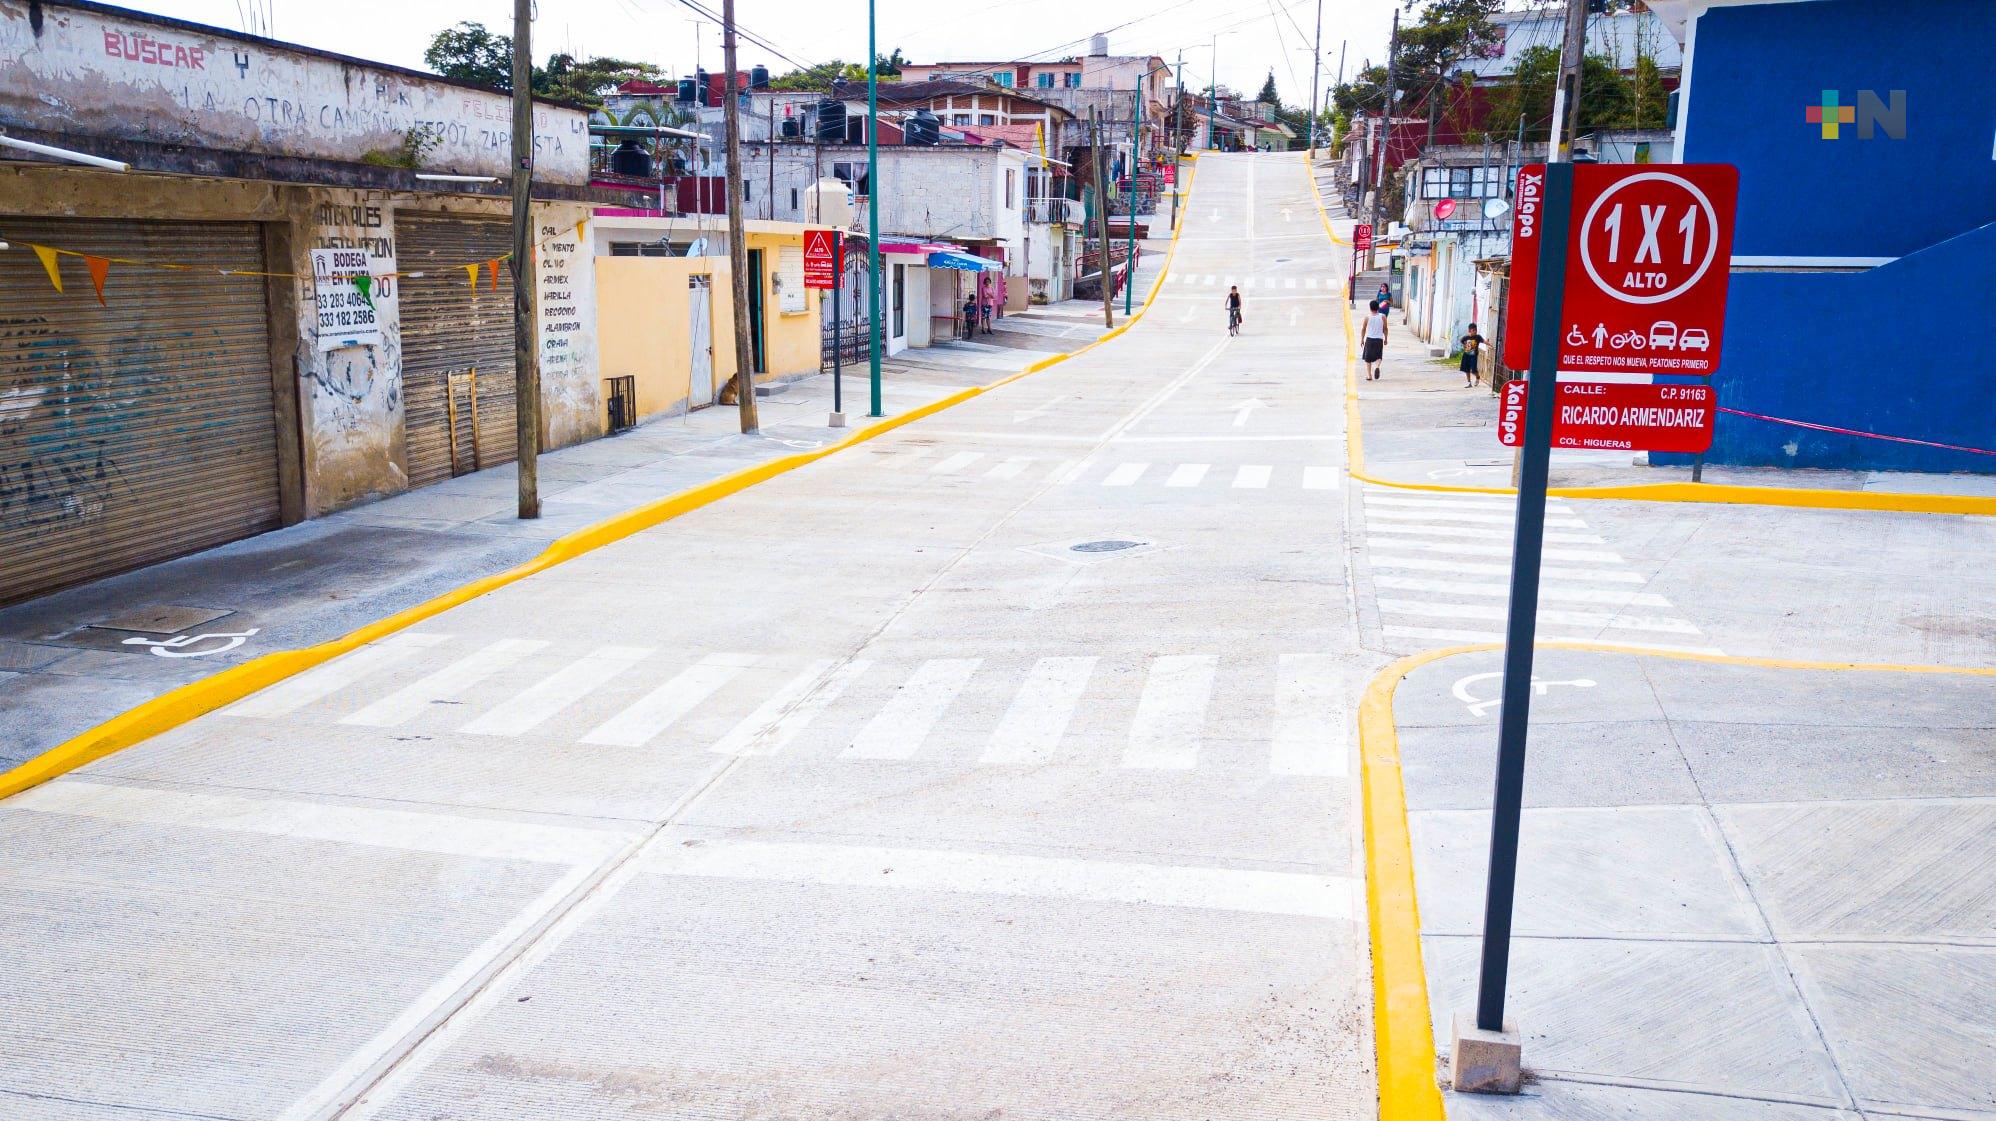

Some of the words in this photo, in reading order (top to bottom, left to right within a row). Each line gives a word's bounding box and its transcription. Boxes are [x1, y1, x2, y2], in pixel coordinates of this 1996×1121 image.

[103, 31, 205, 71] BUSCAR
[244, 96, 307, 125] OTRA
[1517, 174, 1542, 237] Xalapa
[1604, 203, 1623, 263] 1
[1633, 204, 1667, 264] X
[1678, 204, 1698, 265] 1
[333, 252, 367, 268] BODEGA
[331, 270, 344, 286] EN
[1622, 271, 1668, 289] ALTO
[329, 292, 345, 309] 283
[318, 311, 335, 328] 333
[335, 310, 352, 327] 182
[352, 309, 376, 325] 2586
[1562, 354, 1577, 365] QUE
[1576, 355, 1584, 365] EL
[1584, 355, 1613, 366] RESPETO
[1612, 356, 1626, 367] NOS
[1648, 358, 1681, 369] PEATONES
[1681, 359, 1709, 370] PRIMERO
[1563, 385, 1607, 395] CALLE:
[1660, 387, 1678, 400] C.P.
[1679, 388, 1706, 401] 91163
[1501, 383, 1525, 444] Xalapa
[1561, 405, 1619, 426] RICARDO
[1620, 406, 1705, 428] ARMENDARIZ
[1559, 436, 1582, 446] COL:
[1583, 438, 1632, 449] HIGUERAS
